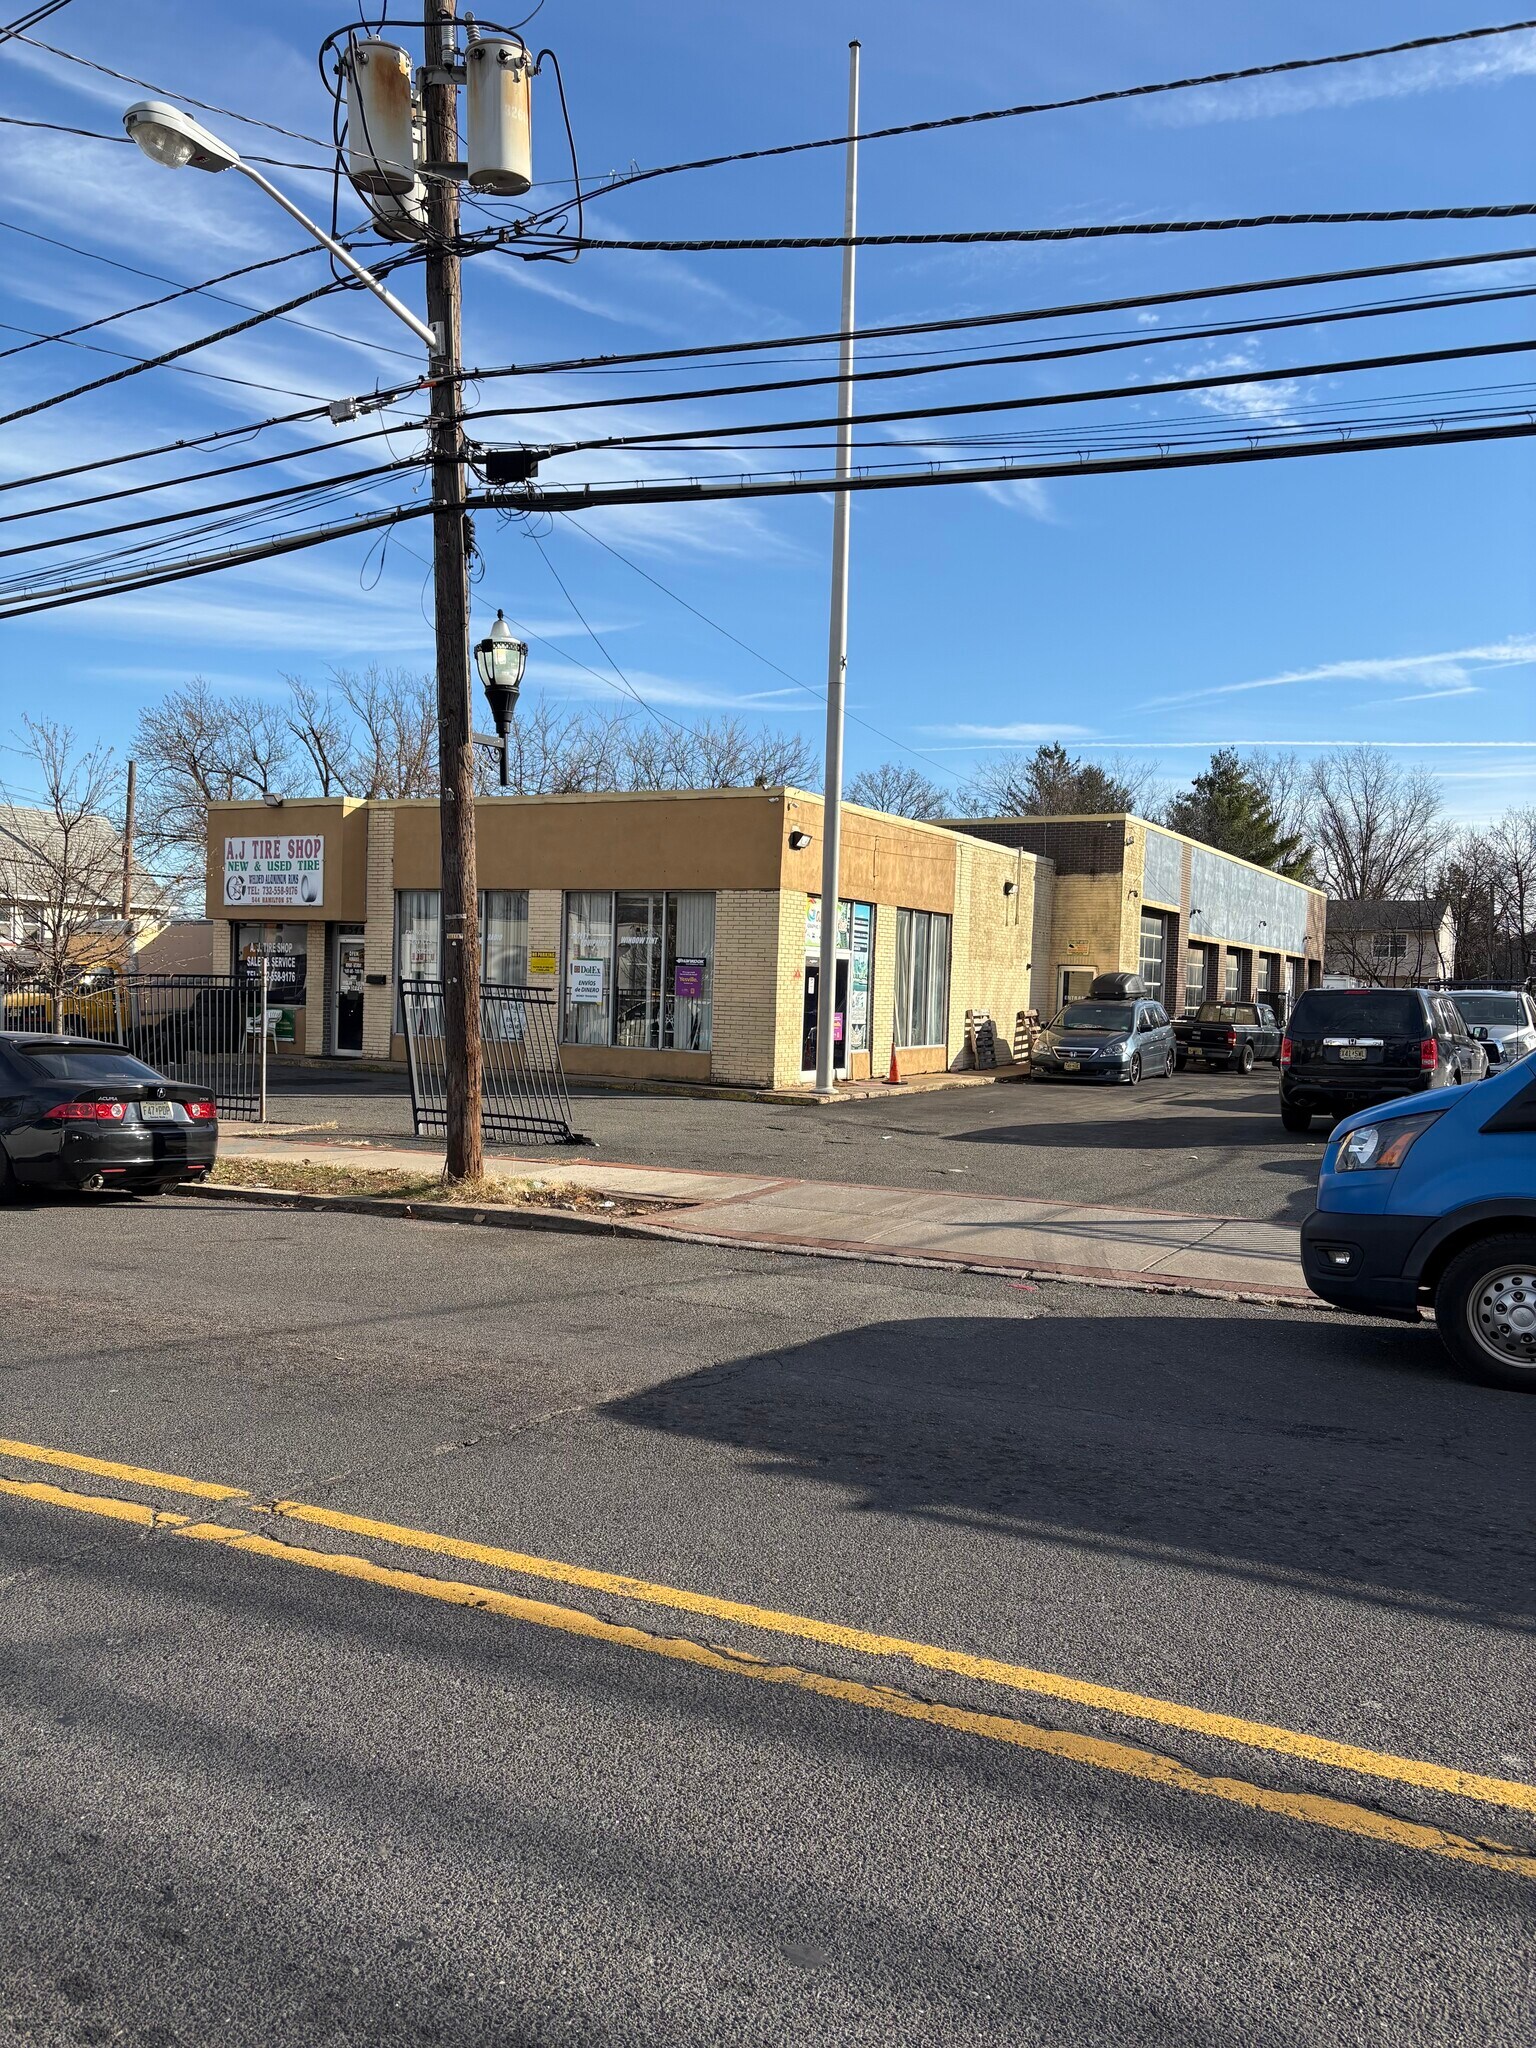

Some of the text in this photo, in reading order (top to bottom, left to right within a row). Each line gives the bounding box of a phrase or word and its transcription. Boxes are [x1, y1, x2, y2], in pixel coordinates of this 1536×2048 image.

[226, 839, 321, 859] A.J TIRE SHOP
[228, 860, 320, 872] NEW & USED TIRE
[288, 874, 299, 884] RIMS
[248, 886, 298, 895] TEL: 732-558-9176
[263, 942, 276, 952] TIRE
[277, 943, 292, 953] SHOP
[271, 957, 295, 967] SERVICE
